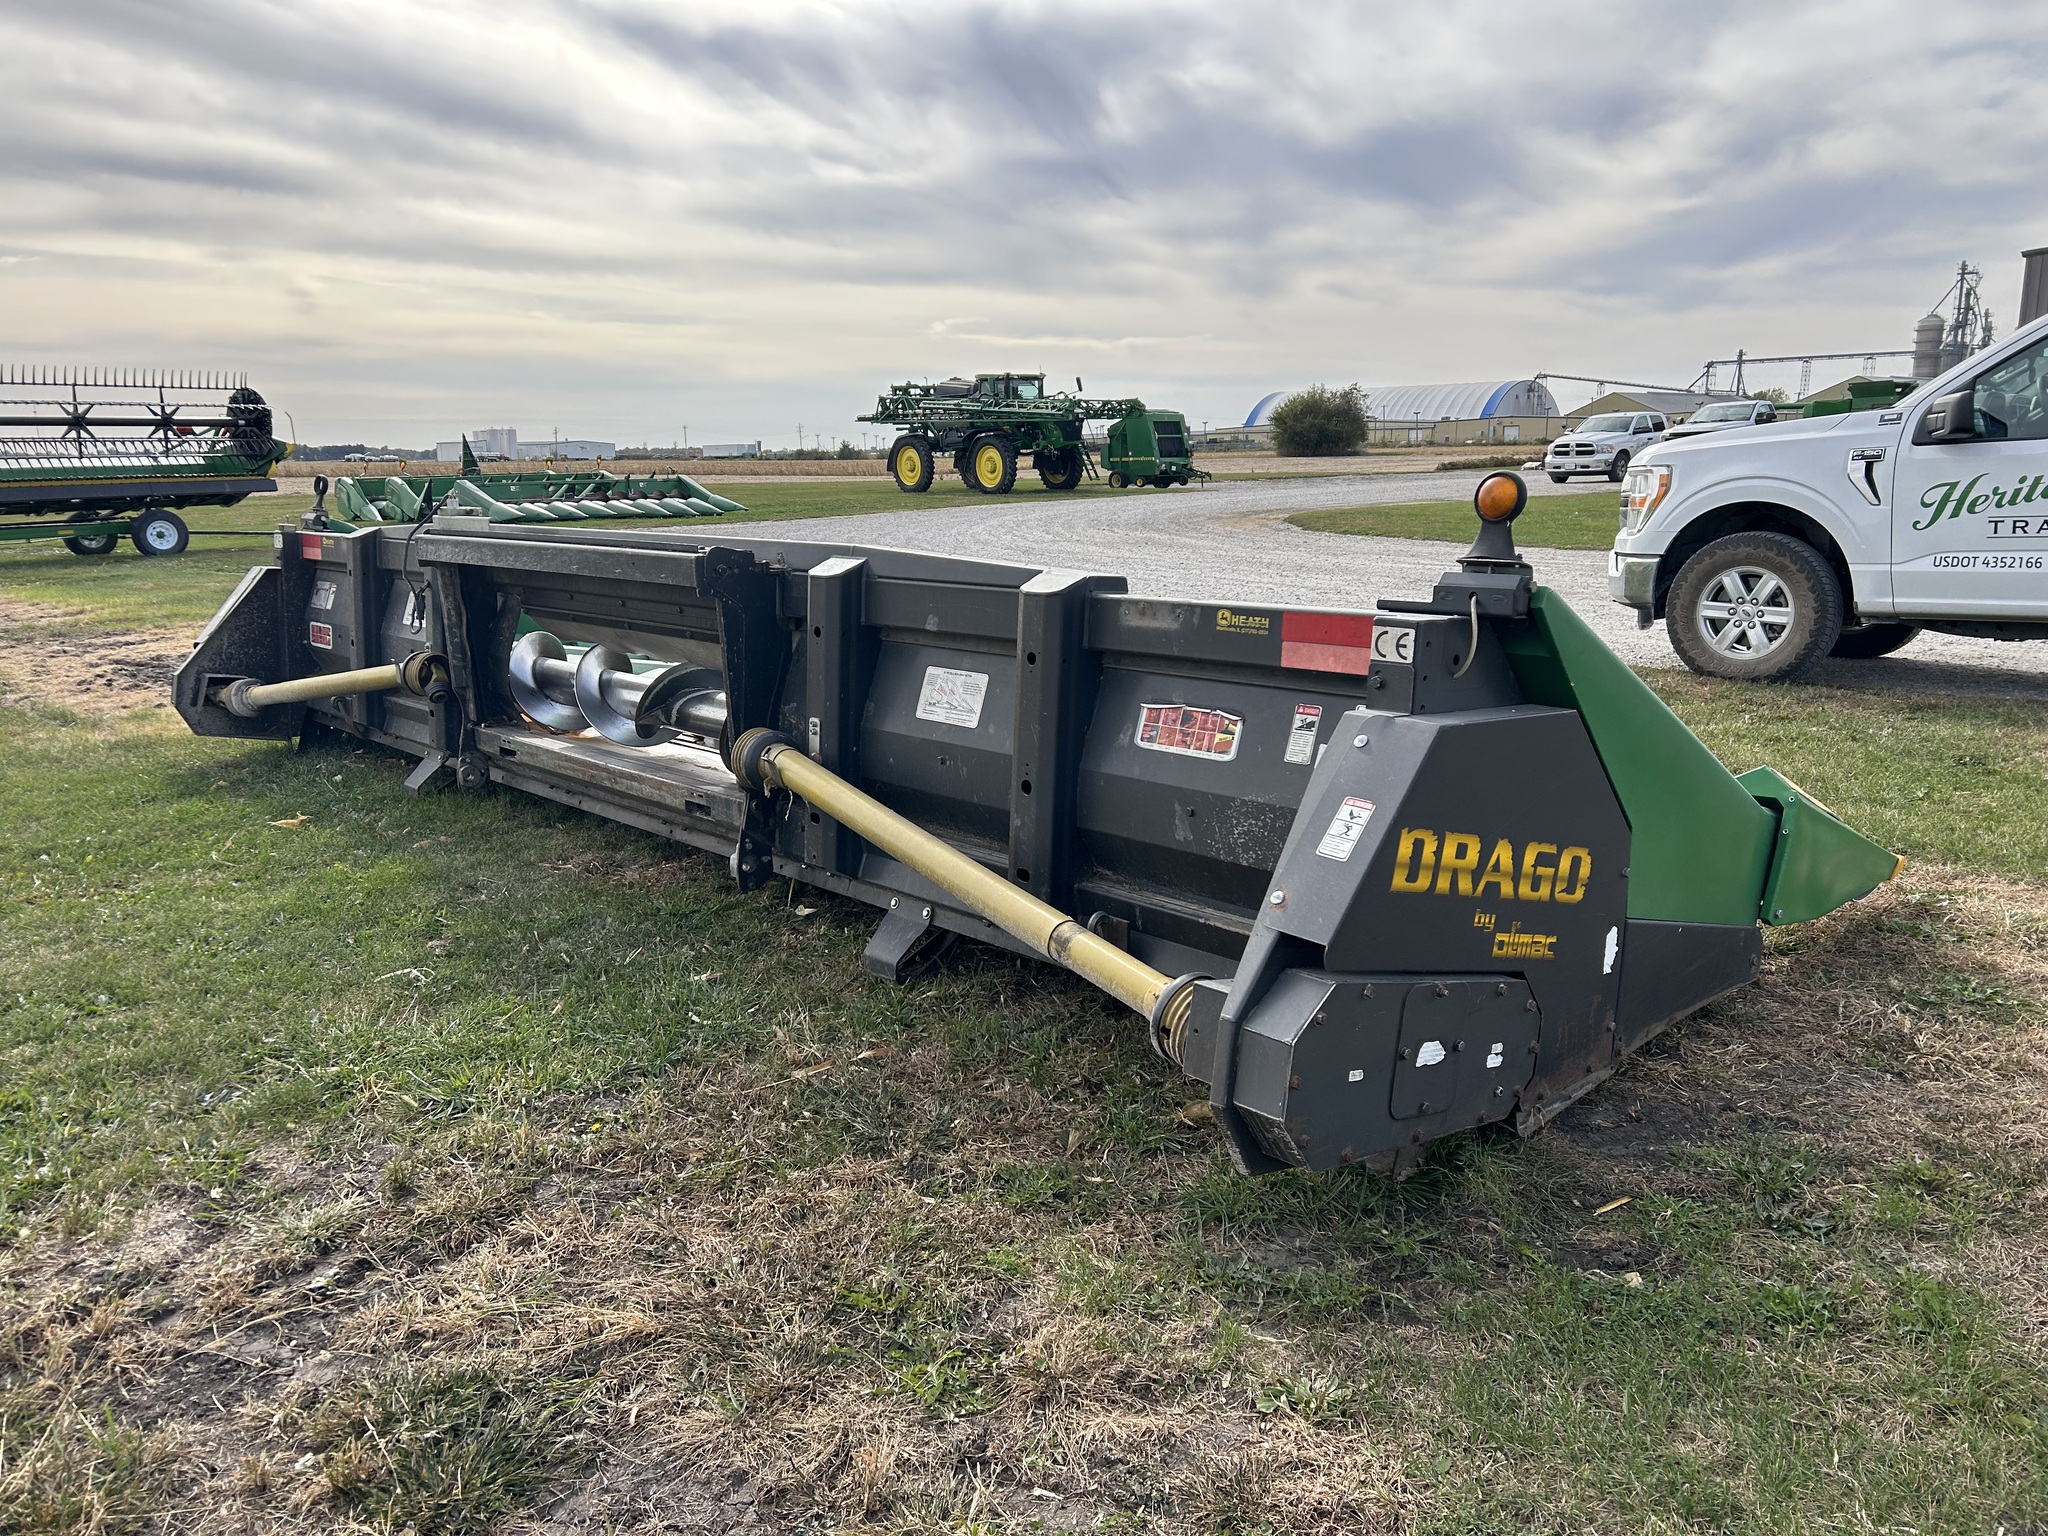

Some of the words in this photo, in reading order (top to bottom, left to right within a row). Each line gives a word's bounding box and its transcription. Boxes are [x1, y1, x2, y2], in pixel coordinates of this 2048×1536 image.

[1933, 556, 1979, 568] USDOT
[1981, 556, 2043, 569] 4352166
[1231, 615, 1270, 628] HEATH
[1374, 630, 1409, 661] CE
[1388, 826, 1593, 905] DRAGO
[1473, 908, 1497, 932] by
